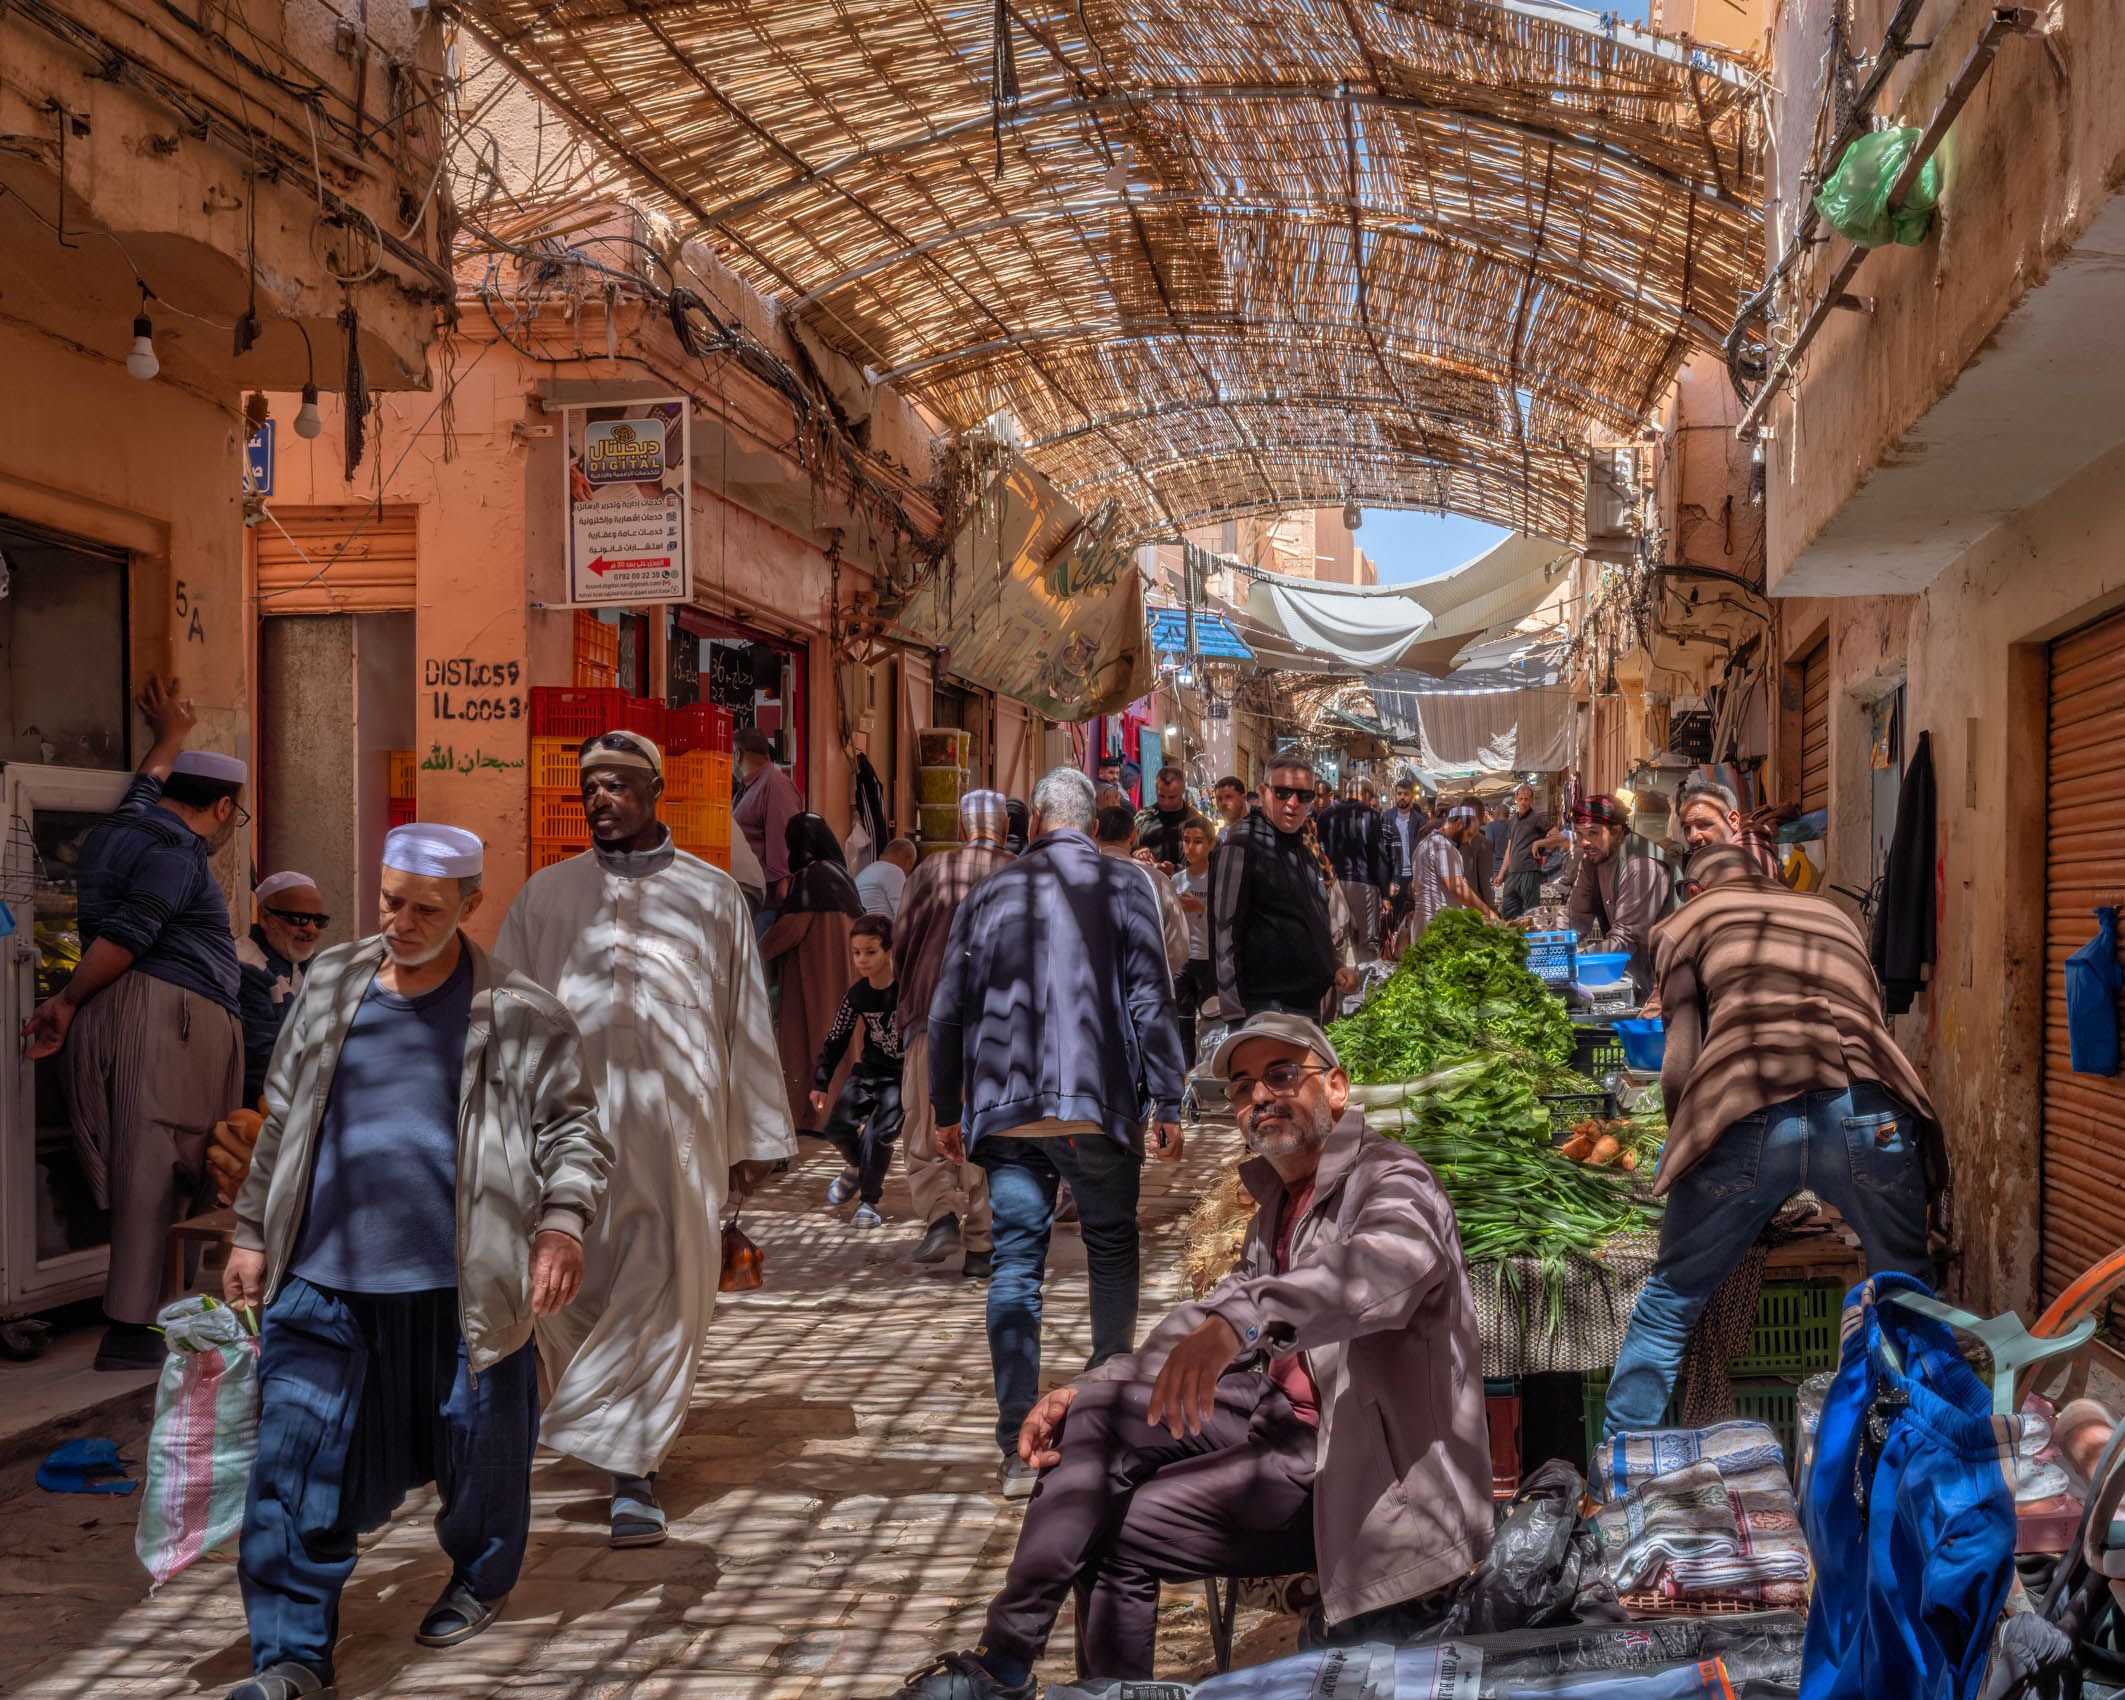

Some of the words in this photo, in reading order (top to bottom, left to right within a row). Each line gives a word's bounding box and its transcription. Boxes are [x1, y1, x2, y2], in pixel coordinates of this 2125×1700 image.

[590, 439, 660, 462] ديجيتال
[590, 459, 660, 471] DIGITAL
[641, 513, 663, 521] خدمات
[638, 528, 663, 536] خدمات
[624, 542, 663, 552] استشارات
[176, 580, 188, 617] 5
[188, 607, 204, 644] A
[458, 747, 524, 774] سبحان
